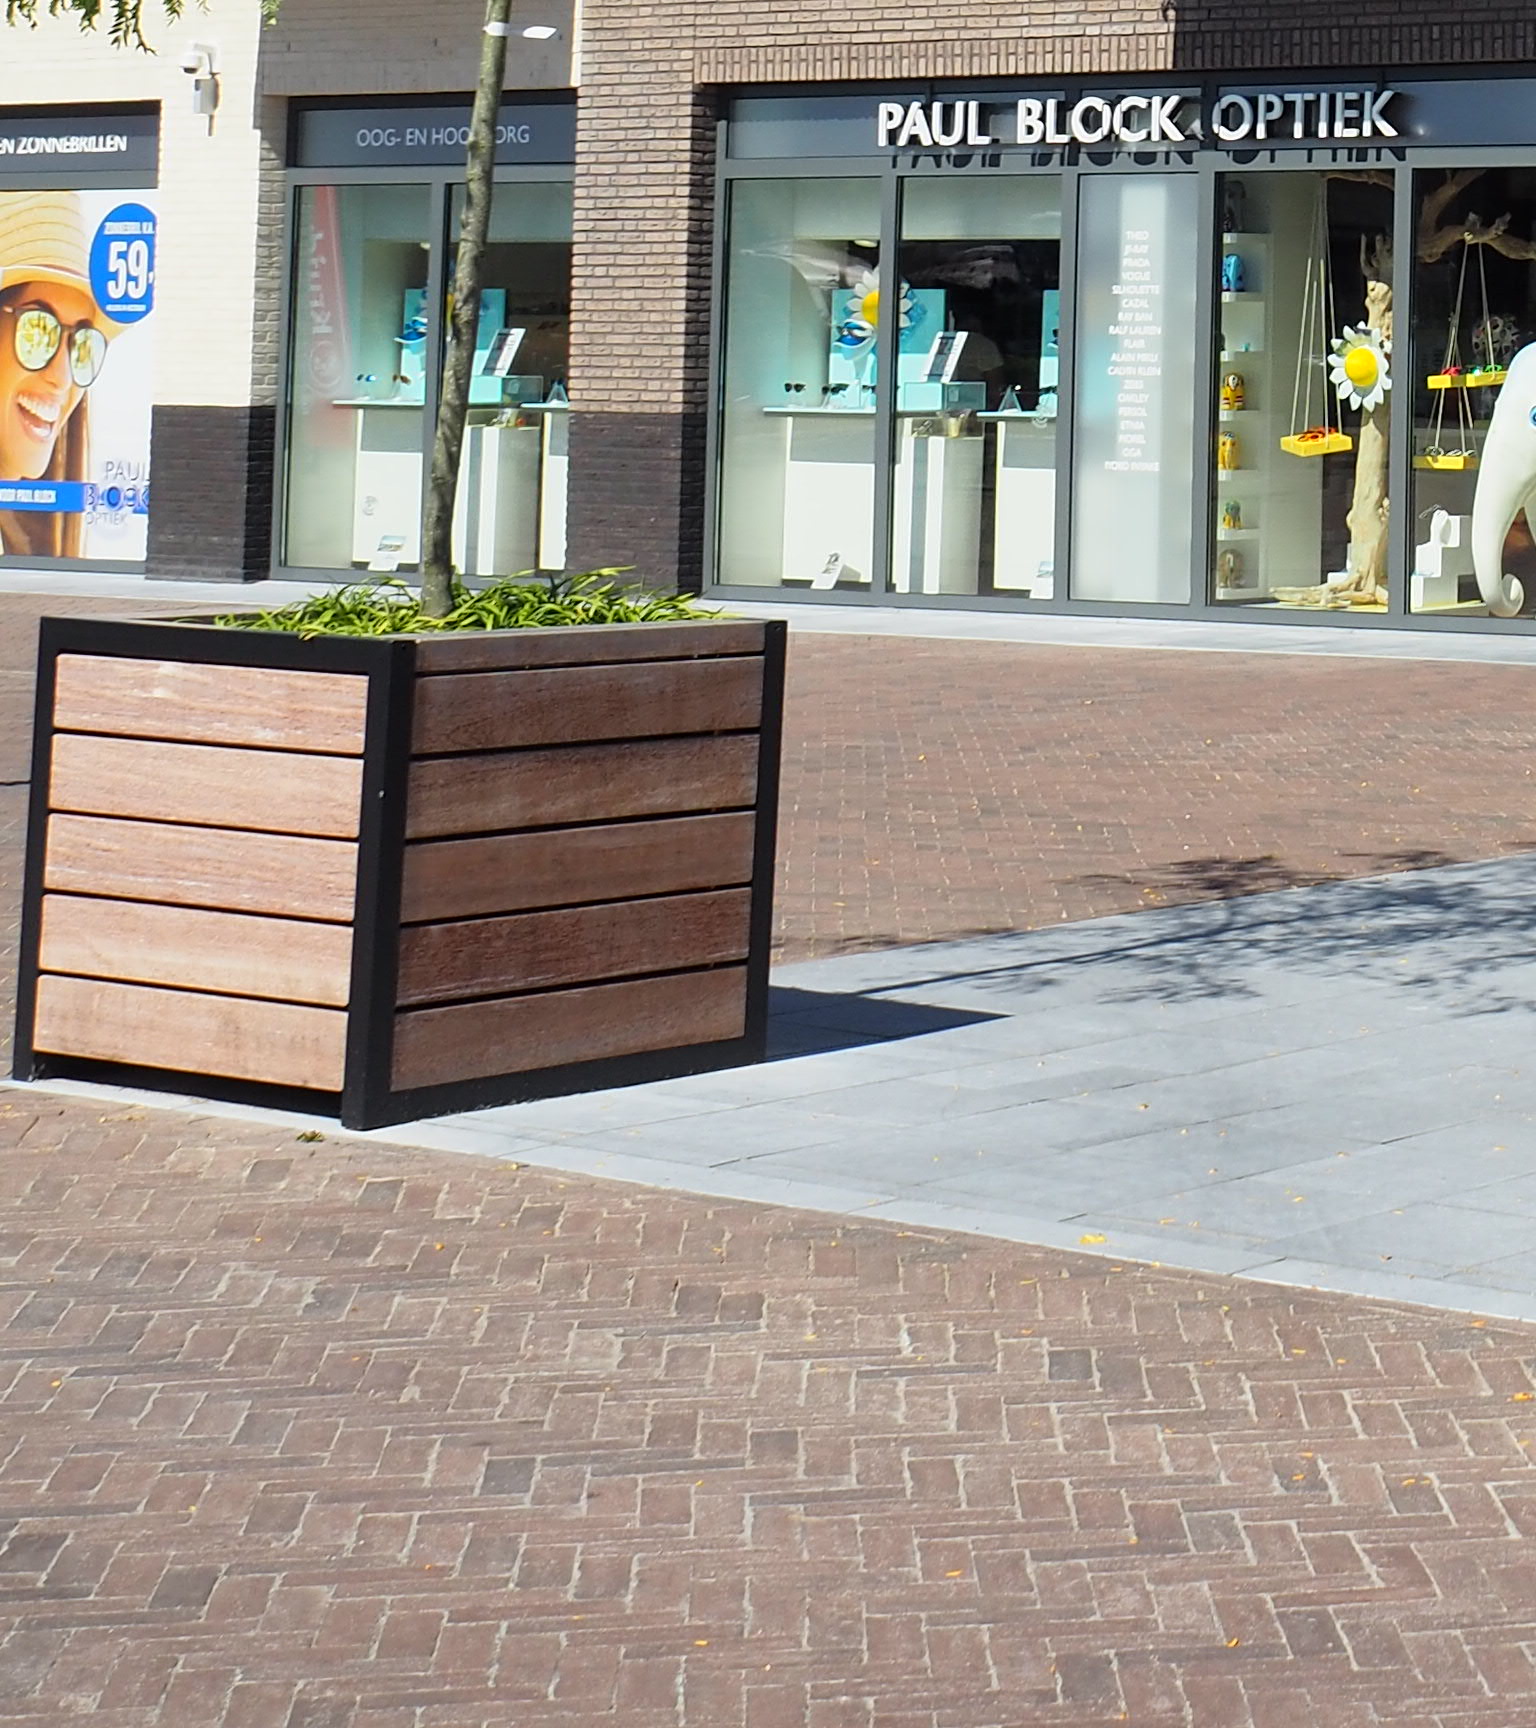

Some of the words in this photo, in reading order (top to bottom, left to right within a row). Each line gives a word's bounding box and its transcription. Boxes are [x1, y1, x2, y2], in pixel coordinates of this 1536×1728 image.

[877, 100, 991, 146] PAUL
[1016, 94, 1187, 145] BLOCK
[1212, 90, 1399, 141] OPTIEK
[16, 135, 128, 154] ZONNEBRILLEN
[356, 128, 401, 147] OOG-
[405, 127, 428, 147] EN
